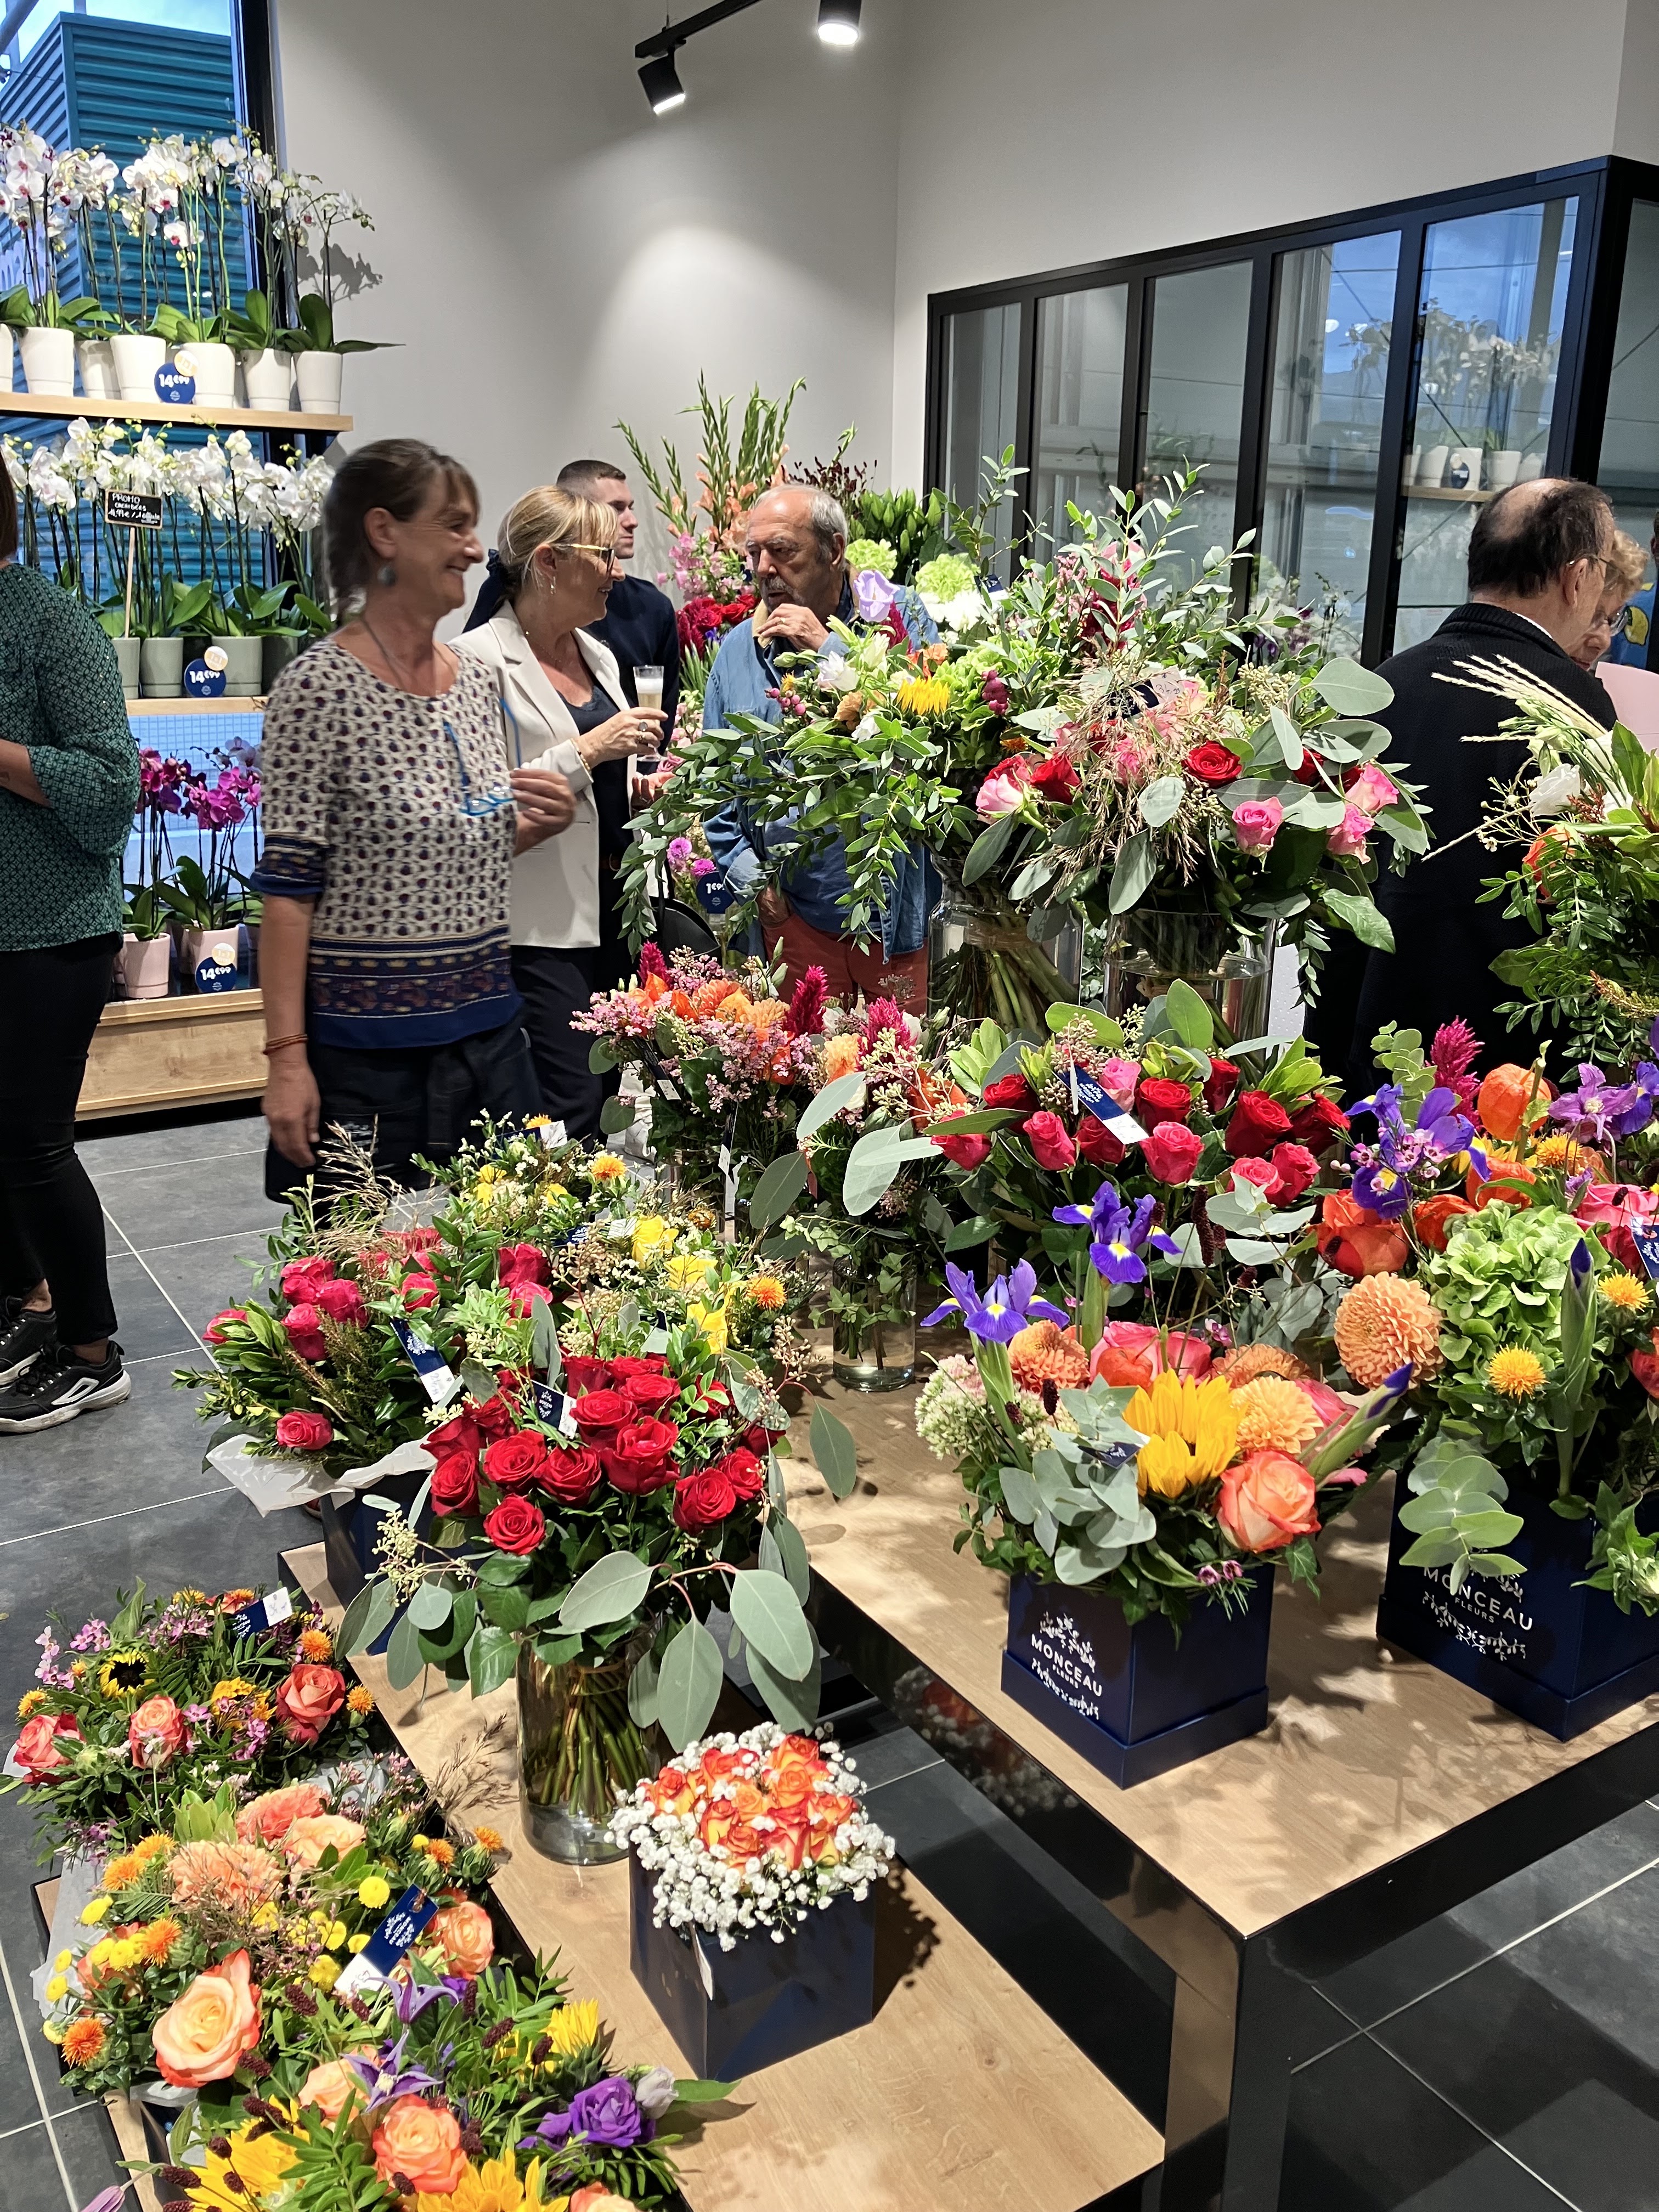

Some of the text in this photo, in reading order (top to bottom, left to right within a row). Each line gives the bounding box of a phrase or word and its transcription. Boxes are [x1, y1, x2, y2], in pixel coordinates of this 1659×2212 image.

[112, 493, 140, 504] PROMO
[200, 967, 231, 980] 14€99
[1455, 1597, 1494, 1623] FLEURS
[1031, 1633, 1103, 1697] MONCEAU
[1052, 1664, 1079, 1689] FLEURS
